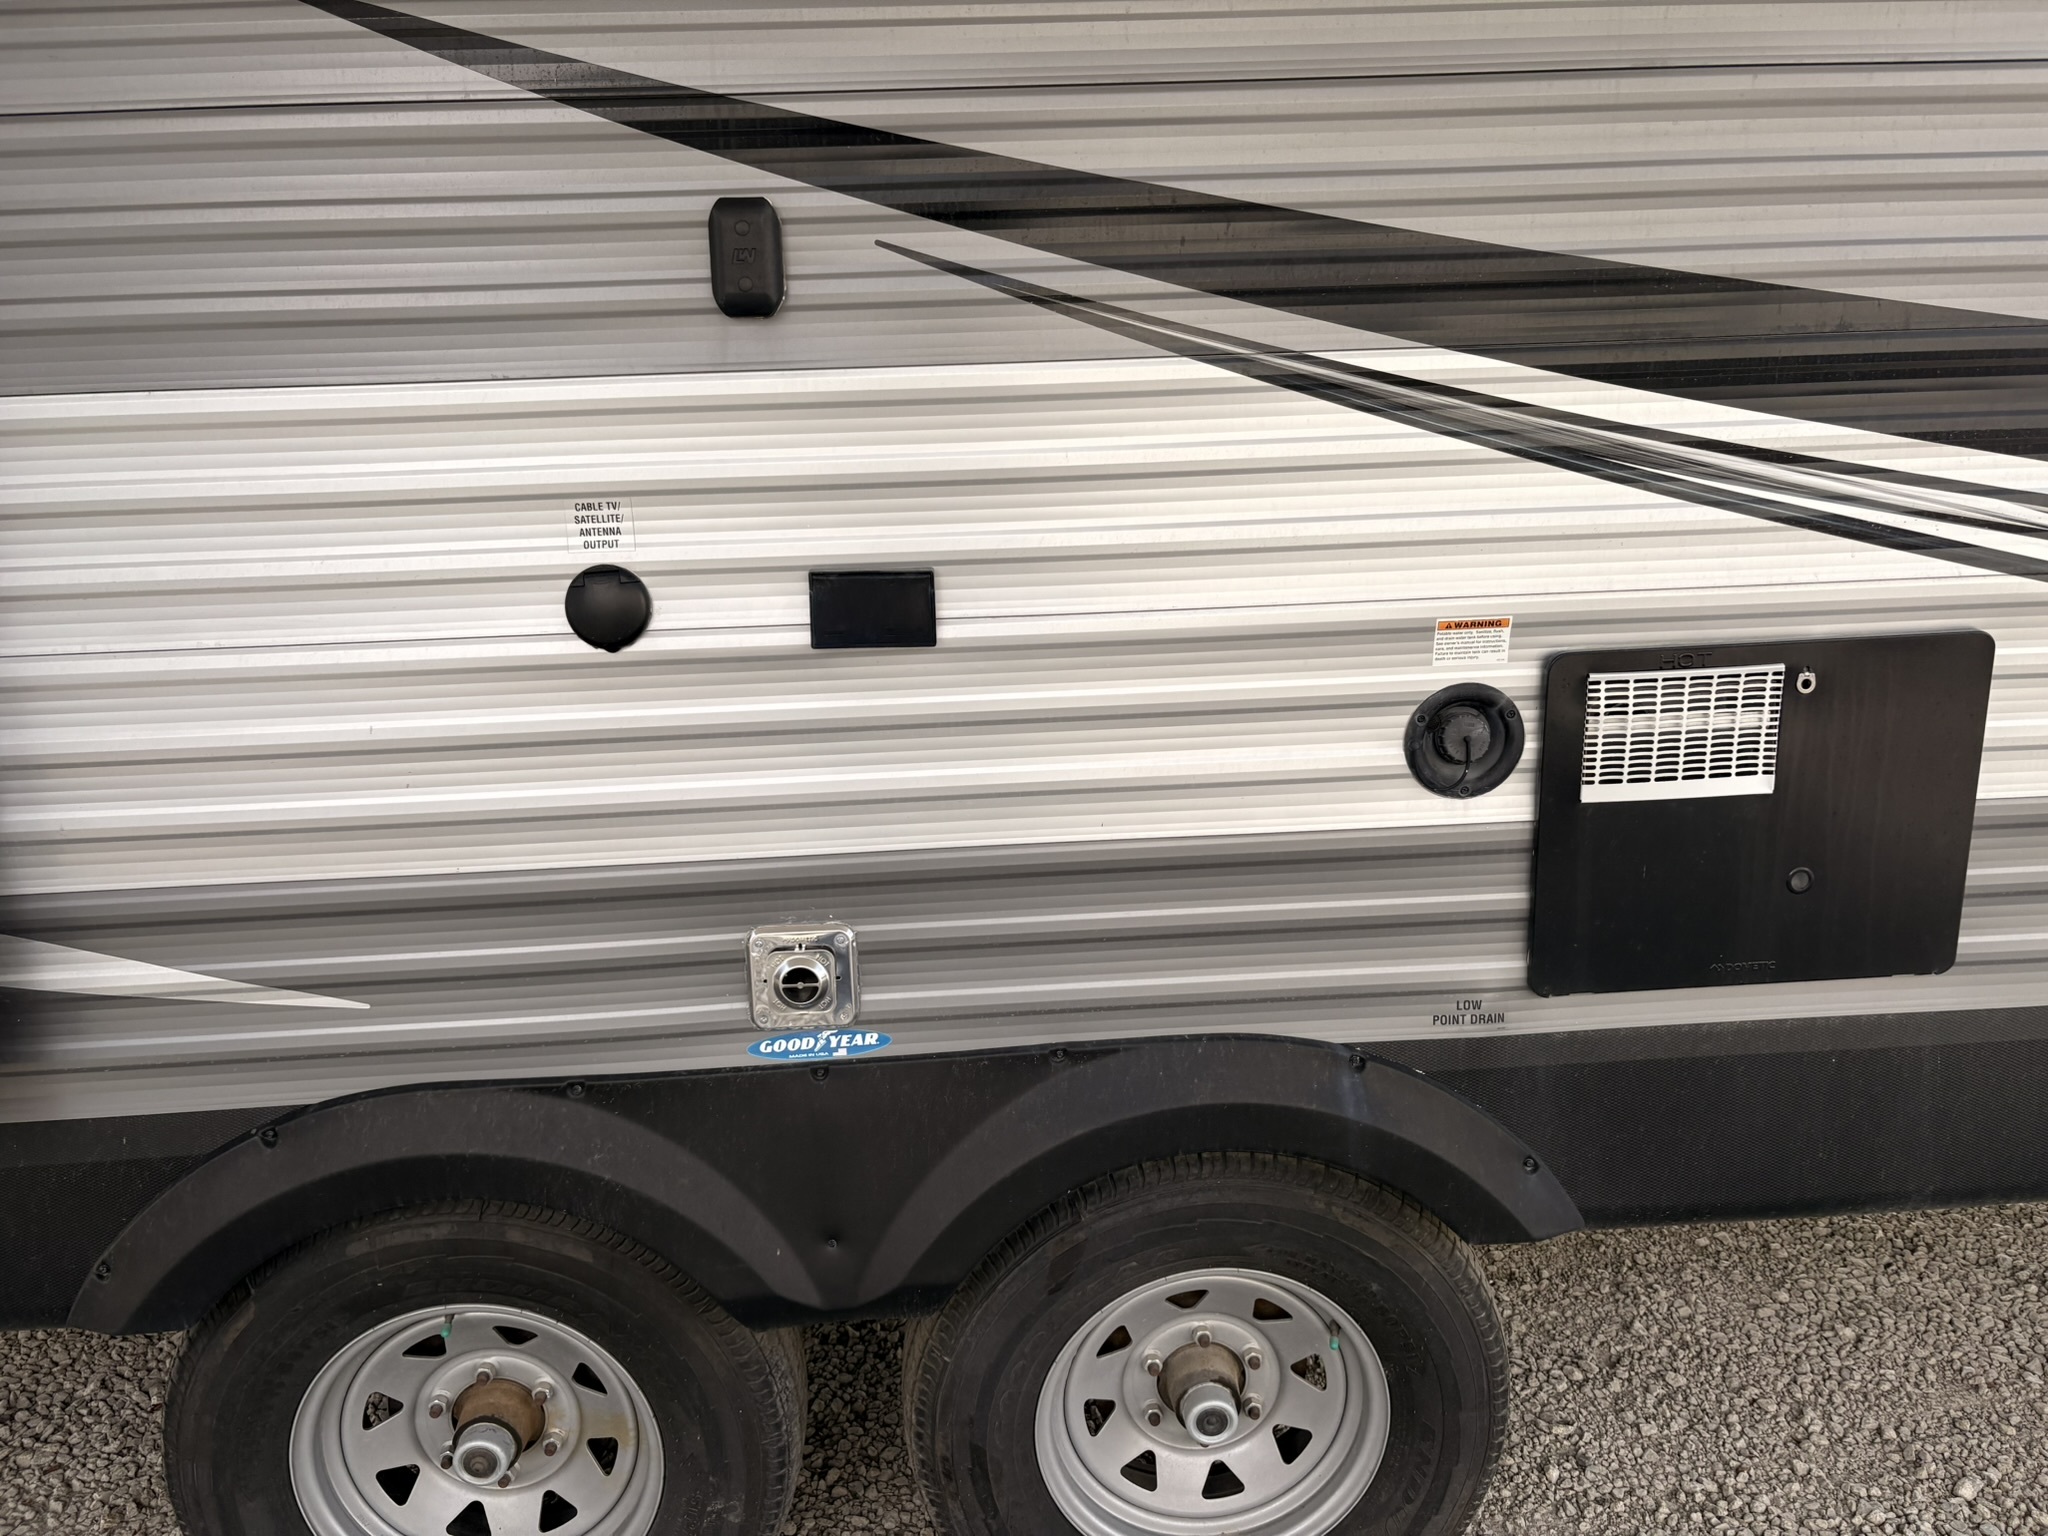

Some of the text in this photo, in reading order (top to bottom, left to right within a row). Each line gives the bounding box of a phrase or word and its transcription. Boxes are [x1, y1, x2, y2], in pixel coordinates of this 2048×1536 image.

[574, 501, 621, 512] CABLE TV/
[574, 514, 624, 525] SATELLITE/
[579, 527, 622, 537] ANTENNA
[583, 539, 620, 550] OUTPUT
[1454, 620, 1502, 629] WARNING
[1660, 652, 1713, 669] HOT
[1456, 1000, 1482, 1010] LOW
[1432, 1012, 1505, 1026] POINT DRAIN
